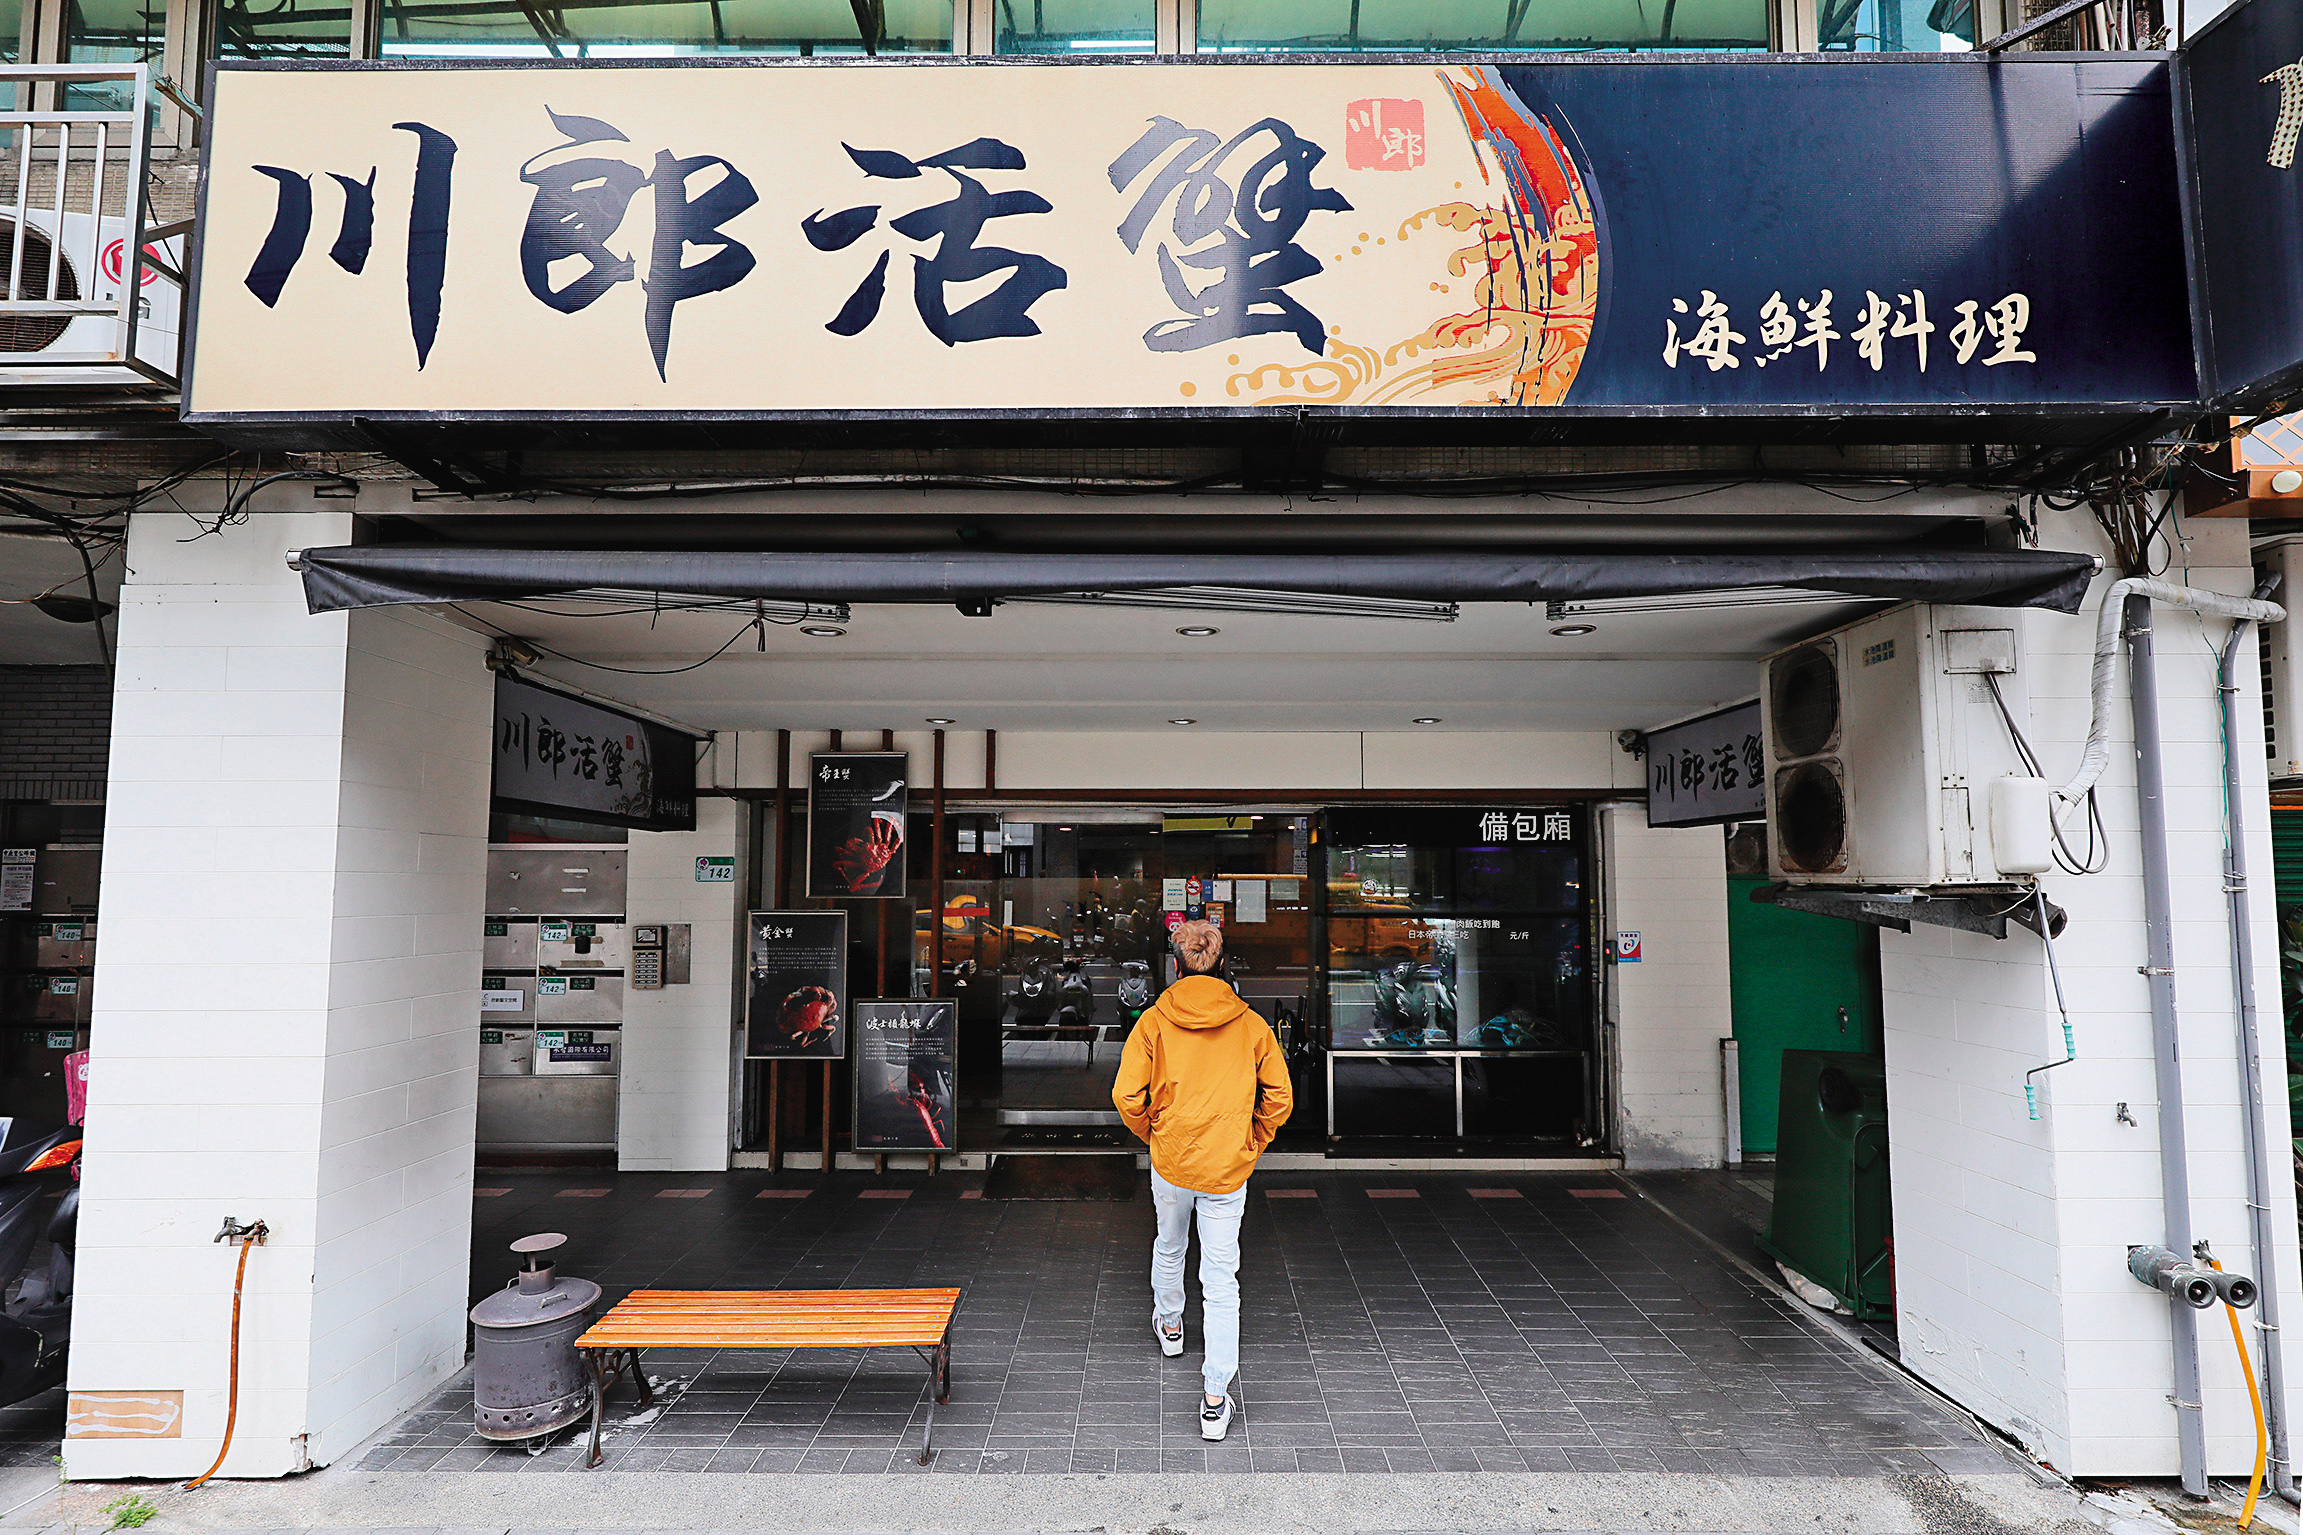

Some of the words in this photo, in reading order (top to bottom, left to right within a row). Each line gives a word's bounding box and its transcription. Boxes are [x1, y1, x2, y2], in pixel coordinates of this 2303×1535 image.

[243, 104, 1355, 383] 川郎活蟹
[1663, 288, 2038, 374] 海鮮料理
[501, 711, 626, 789] 川郎活蟹
[1479, 811, 1572, 841] 備包廂
[709, 867, 731, 879] 142
[547, 931, 561, 940] 142
[1408, 929, 1470, 940] 日本帝三吃
[1509, 931, 1530, 940] 元/斤
[545, 985, 559, 993] 142
[544, 1039, 558, 1047] 142
